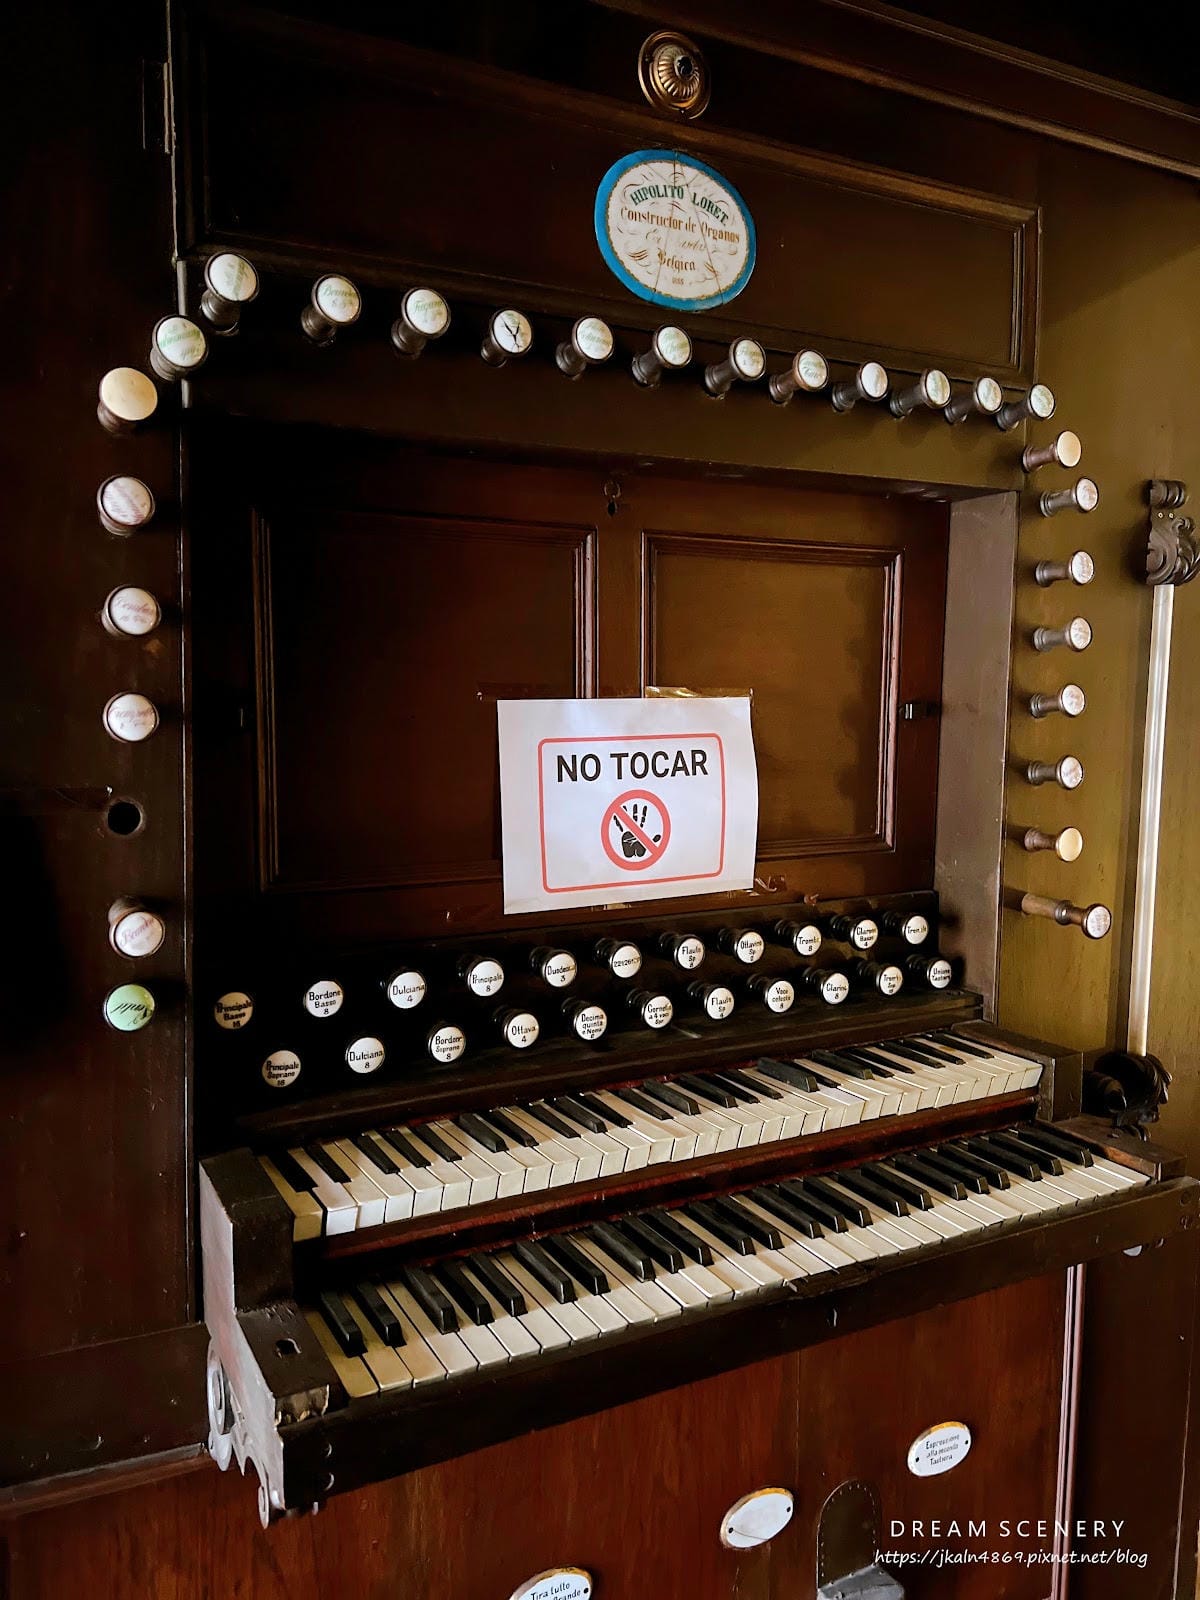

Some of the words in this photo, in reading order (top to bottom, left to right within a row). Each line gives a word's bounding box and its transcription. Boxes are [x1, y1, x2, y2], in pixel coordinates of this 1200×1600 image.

[630, 184, 685, 206] HIPOLITO
[691, 192, 730, 226] LORET
[620, 206, 683, 231] Constructor
[700, 221, 741, 244] Organos
[556, 753, 601, 783] NO
[609, 749, 709, 780] TOCAR
[309, 990, 341, 1001] Bordone
[392, 984, 425, 996] Dulciana
[511, 1025, 536, 1036] Ottava
[349, 1050, 384, 1063] Dulciana
